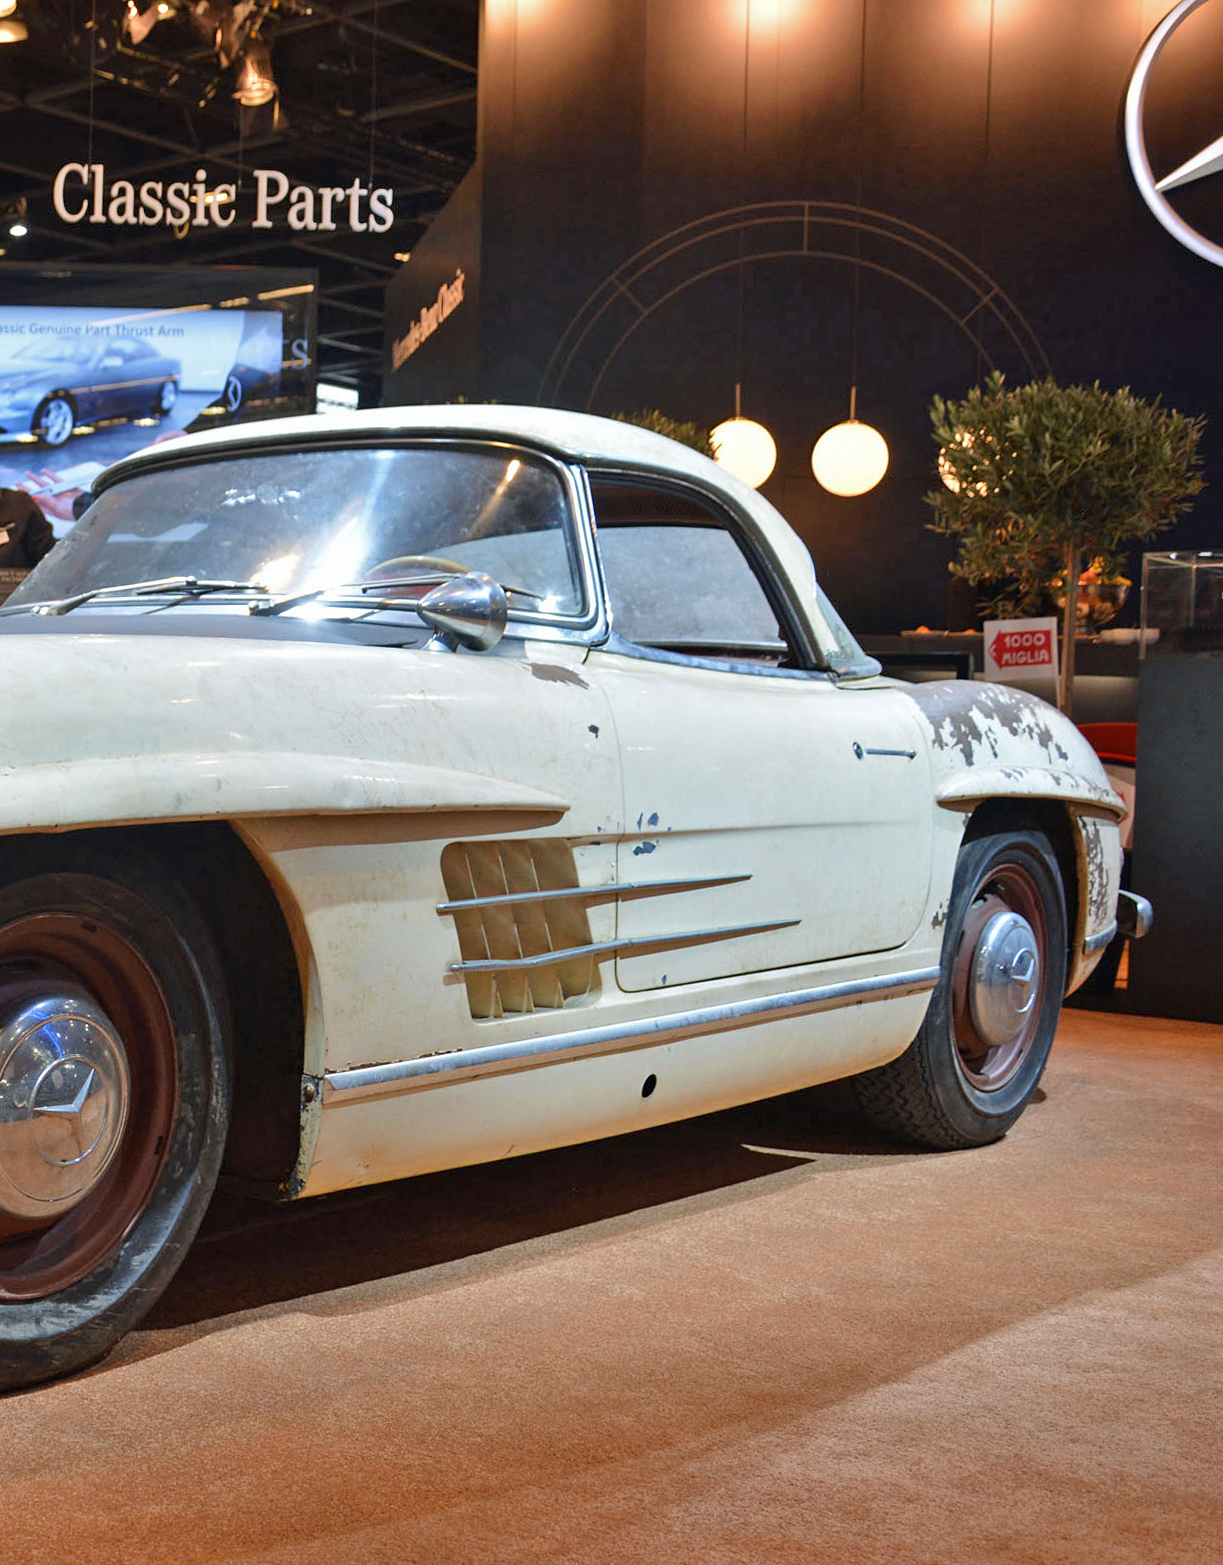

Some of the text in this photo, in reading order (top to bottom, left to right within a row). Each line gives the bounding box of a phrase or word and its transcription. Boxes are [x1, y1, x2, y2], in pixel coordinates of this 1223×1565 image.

[53, 162, 395, 234] Classic Parts
[29, 322, 81, 336] Genuine
[85, 324, 111, 337] Part
[115, 324, 155, 337] Thrust
[158, 325, 185, 338] Arm
[1004, 633, 1046, 648] 1000
[1001, 649, 1050, 665] MIGLIA
